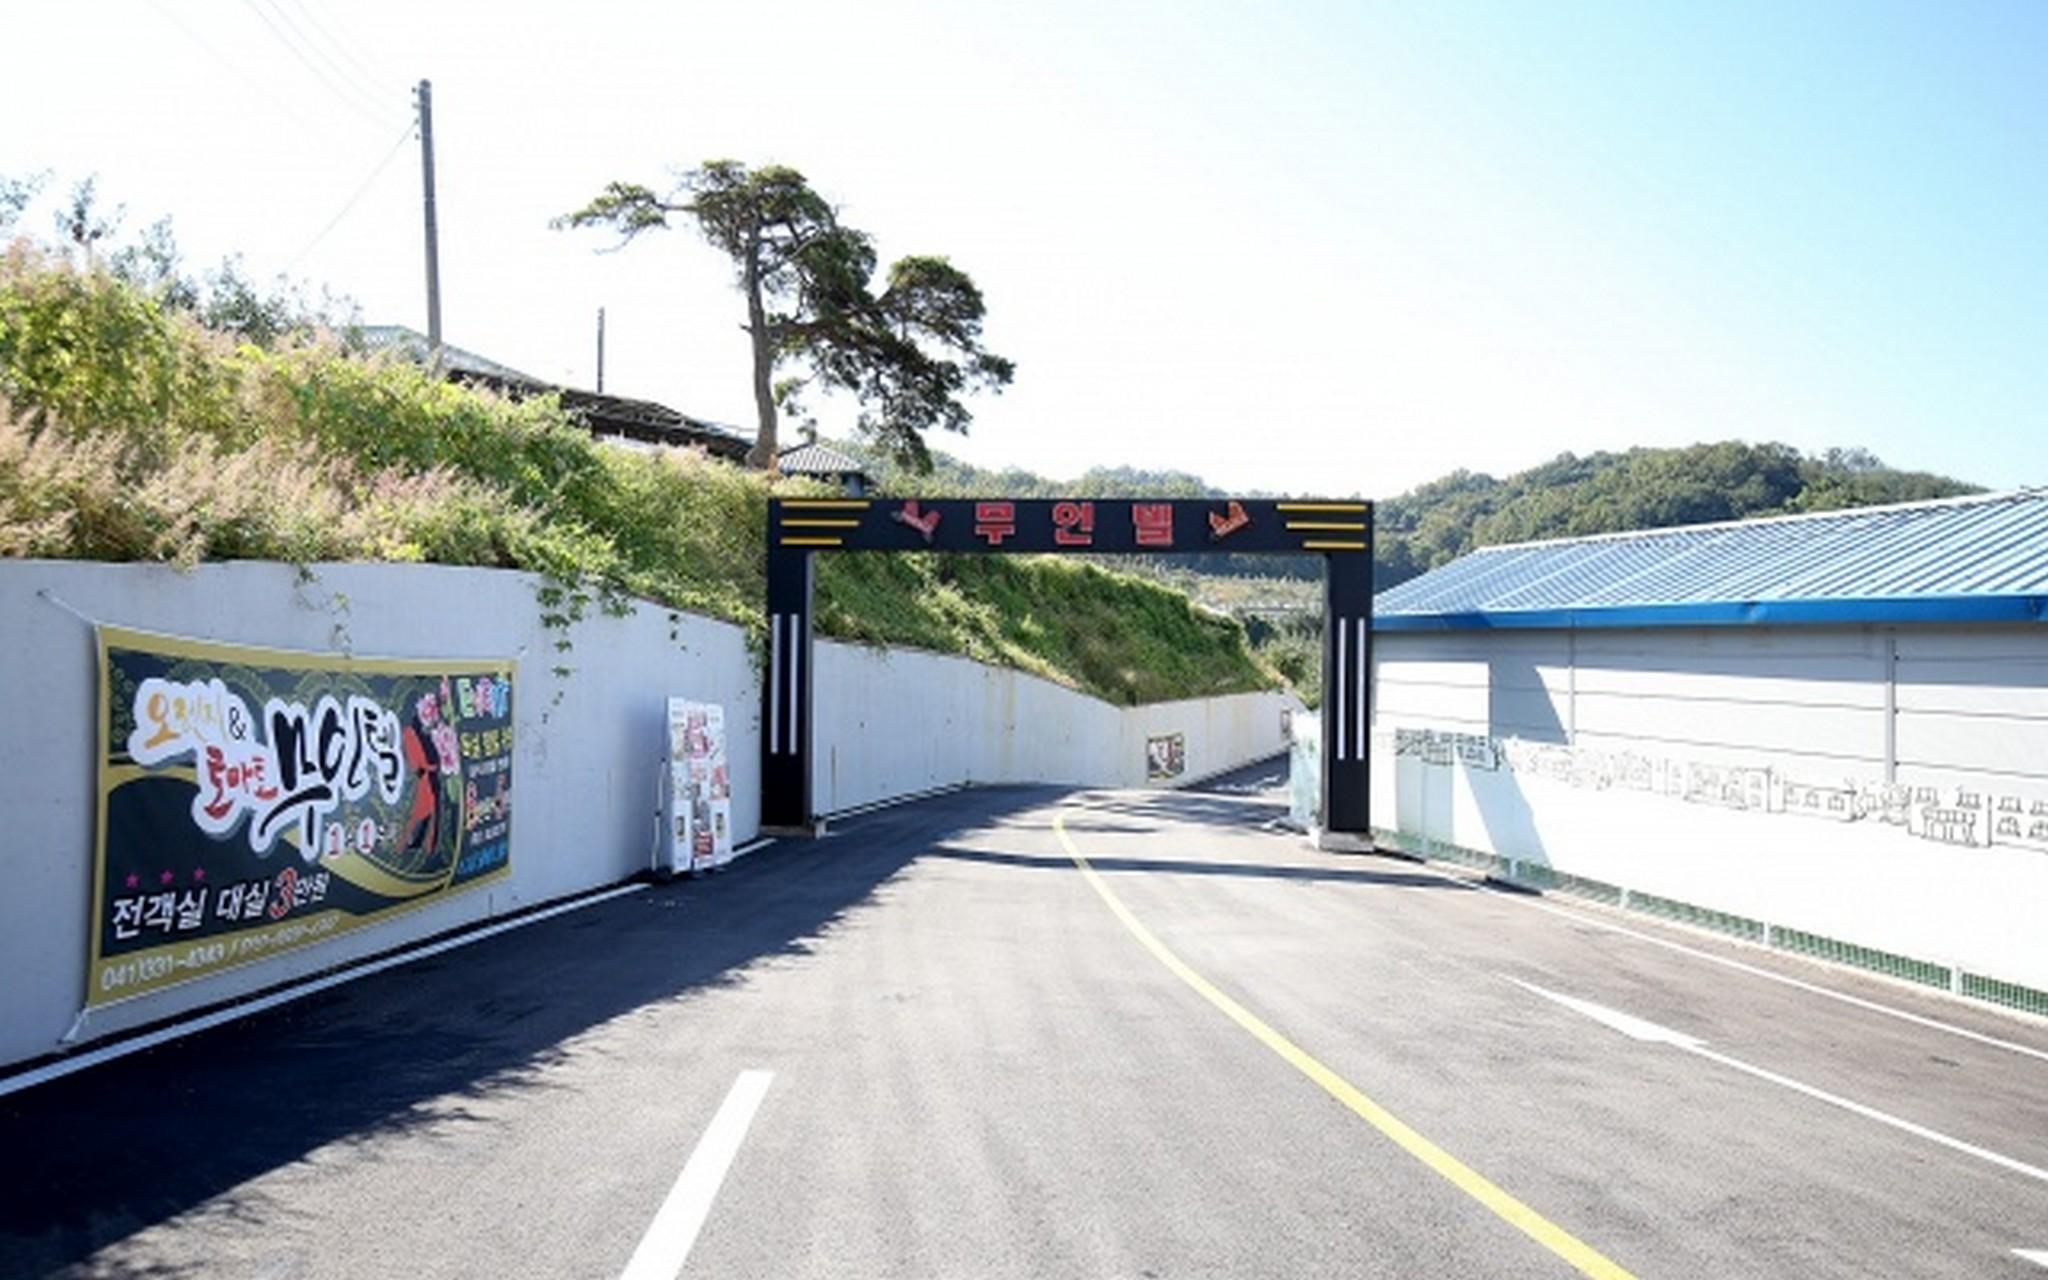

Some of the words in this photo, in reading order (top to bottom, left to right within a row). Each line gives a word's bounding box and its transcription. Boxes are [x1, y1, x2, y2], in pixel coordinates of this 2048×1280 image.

[229, 706, 247, 740] &
[112, 888, 208, 940] 전객실
[215, 880, 271, 921] 대실
